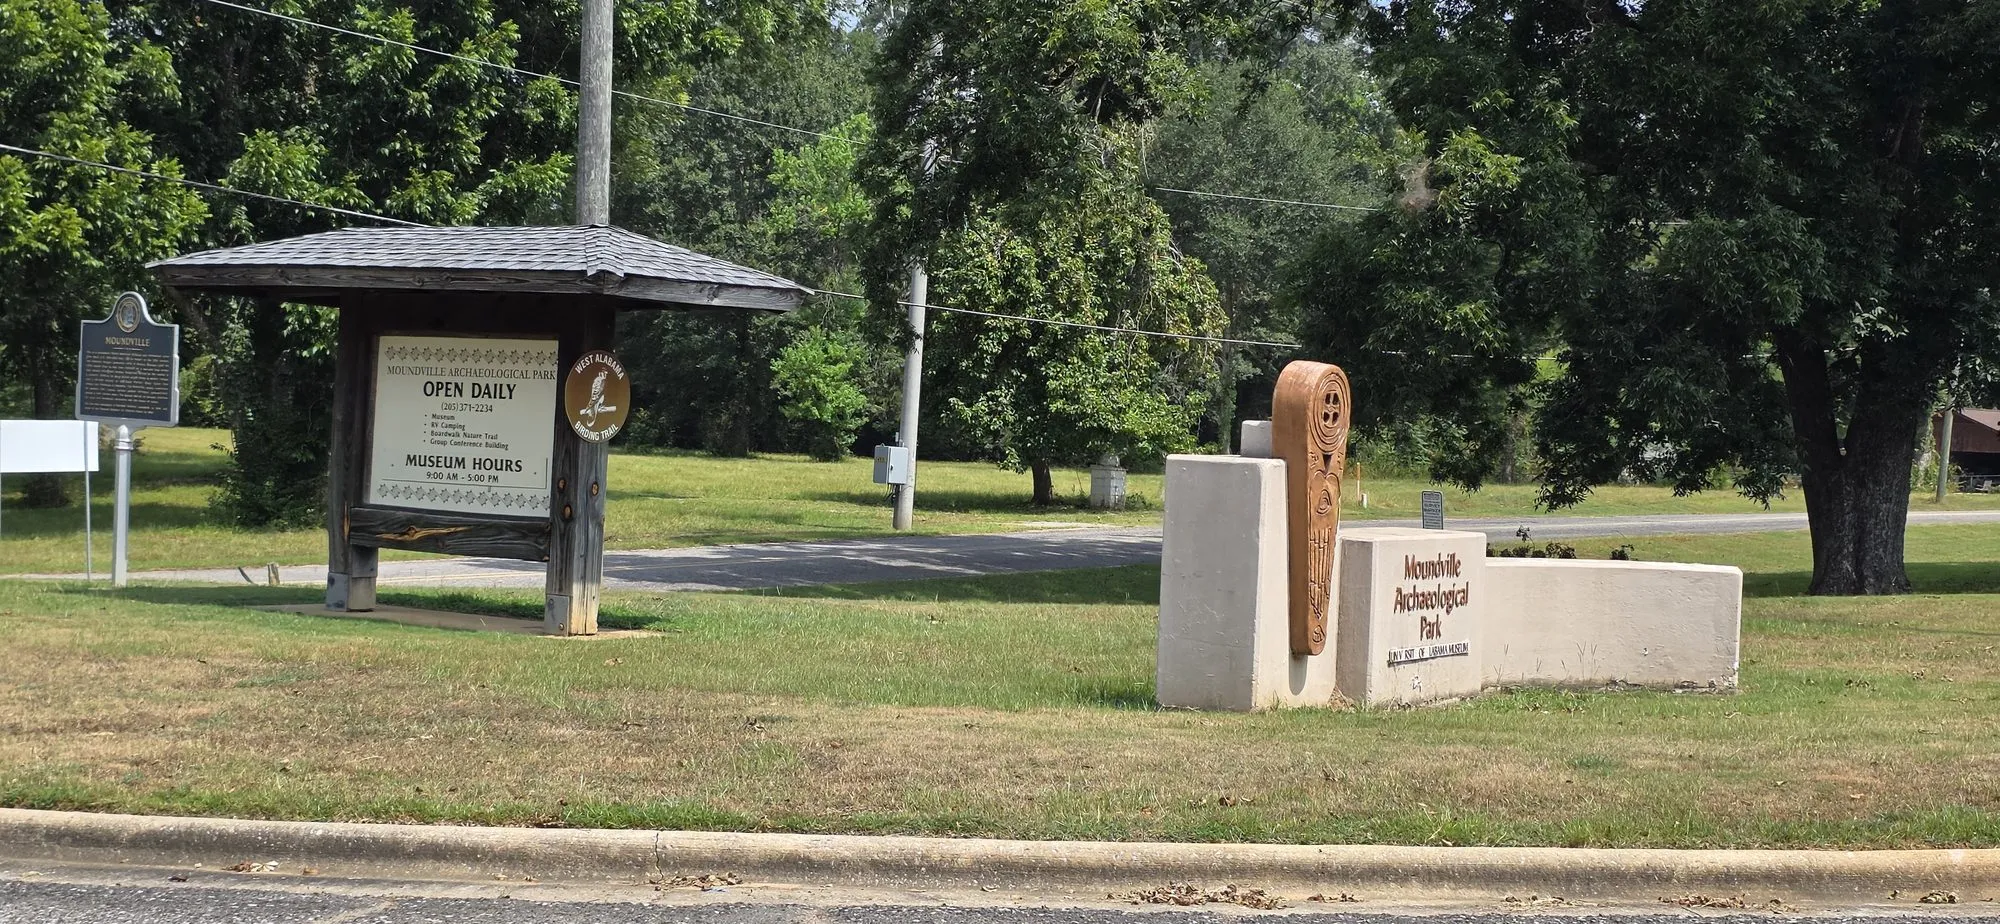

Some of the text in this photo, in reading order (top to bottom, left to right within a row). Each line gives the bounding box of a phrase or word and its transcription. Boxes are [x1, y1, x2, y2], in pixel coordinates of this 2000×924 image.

[105, 336, 150, 347] MOUNDVILLE
[387, 365, 556, 380] MOUNDVILLE ARCHAEOLOGICAL PARK
[574, 353, 625, 380] WEST ALABAMA
[423, 381, 517, 400] OPEN DAILY
[441, 402, 493, 413] (205)371-2234
[431, 413, 455, 421] Museum
[431, 421, 466, 431] RV Camping
[574, 420, 619, 441] BIRDING TRAIL
[430, 430, 461, 439] Boardwalk
[463, 432, 482, 440] Nature
[430, 438, 509, 451] Group Conference Building
[405, 454, 523, 472] MUSEUM HOURS
[426, 471, 444, 480] 9:00
[446, 472, 458, 481] AM
[467, 473, 485, 482] 5:00
[488, 474, 499, 483] PM
[1404, 552, 1461, 580] Moundville
[1393, 581, 1469, 615] Archaeological
[1420, 613, 1442, 640] Park
